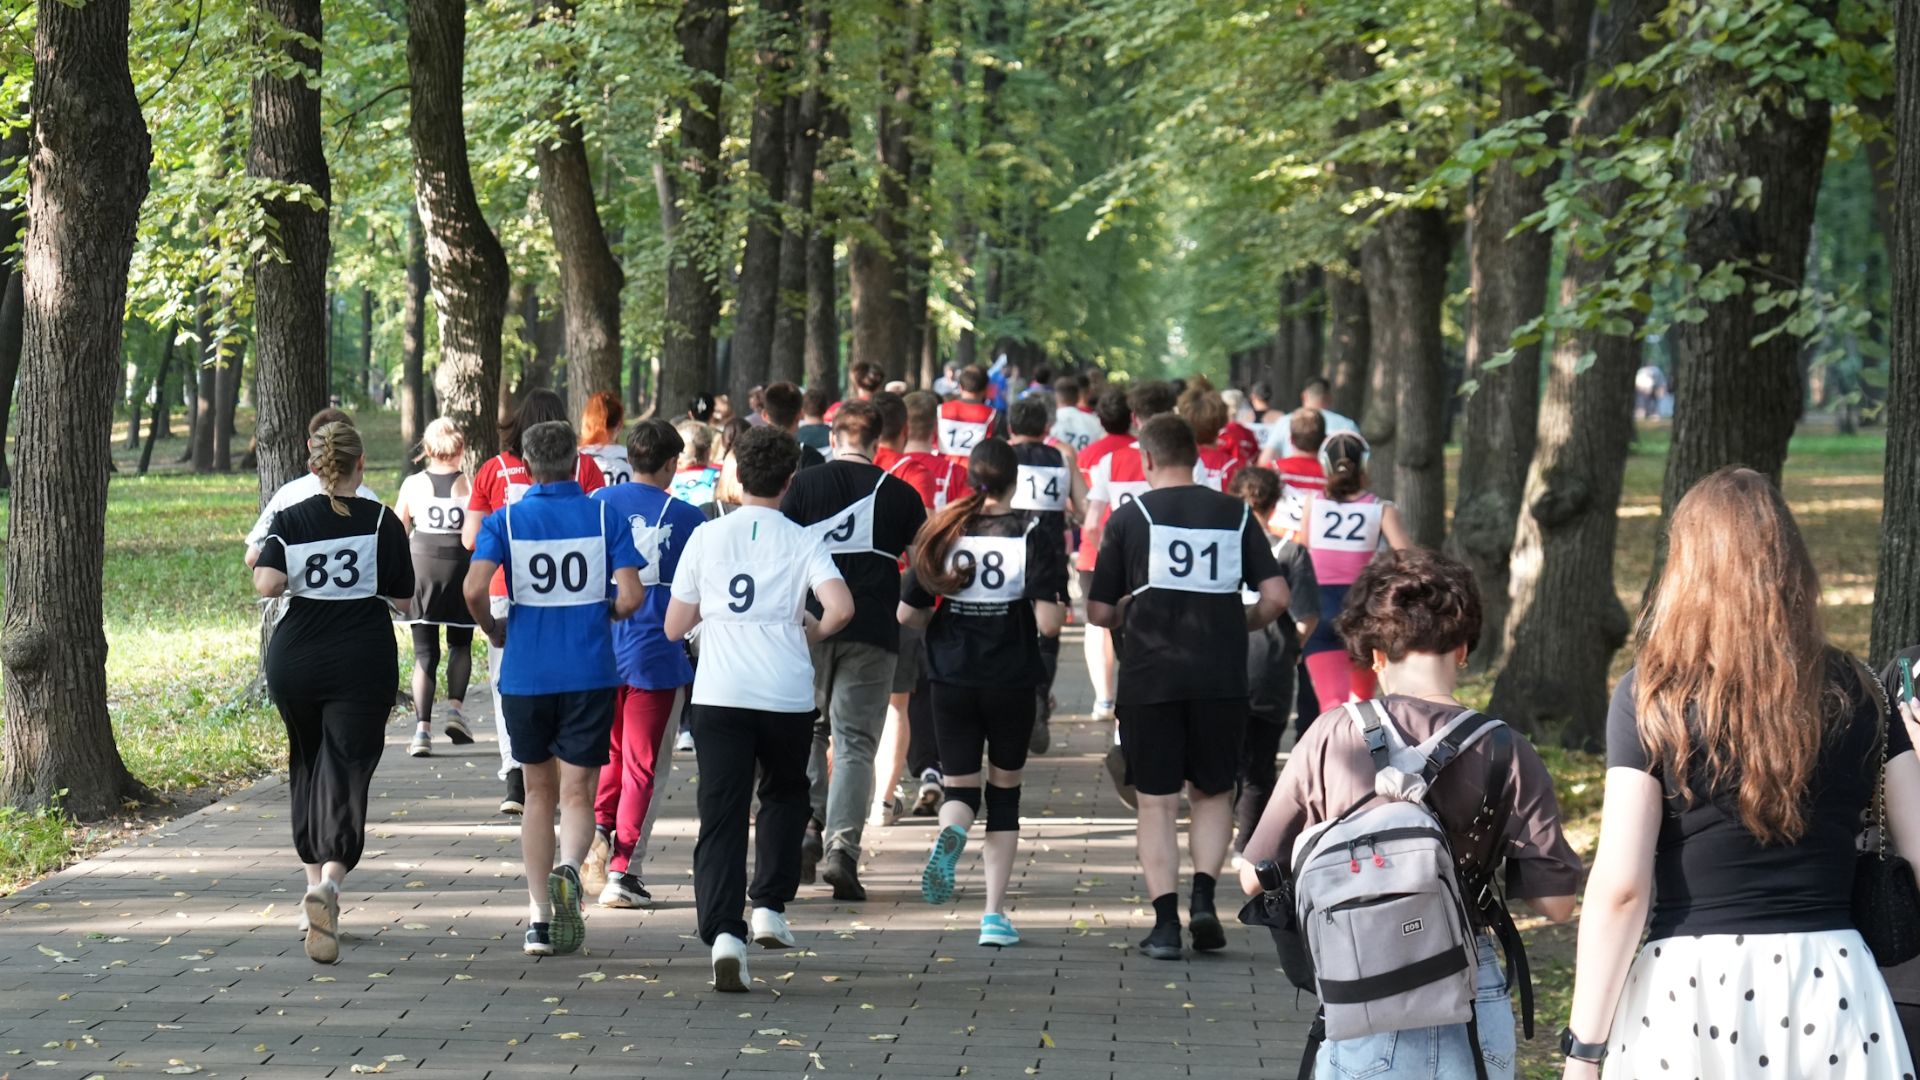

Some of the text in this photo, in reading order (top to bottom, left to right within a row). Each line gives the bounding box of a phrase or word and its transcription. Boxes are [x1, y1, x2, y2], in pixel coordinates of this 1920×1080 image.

[948, 428, 974, 449] 12
[1026, 475, 1060, 502] 14
[428, 505, 465, 530] 99
[1323, 511, 1366, 541] 22
[305, 548, 360, 589] 83
[528, 551, 588, 595] 90
[952, 549, 1005, 590] 98
[1168, 539, 1218, 581] 91
[728, 573, 755, 614] 9
